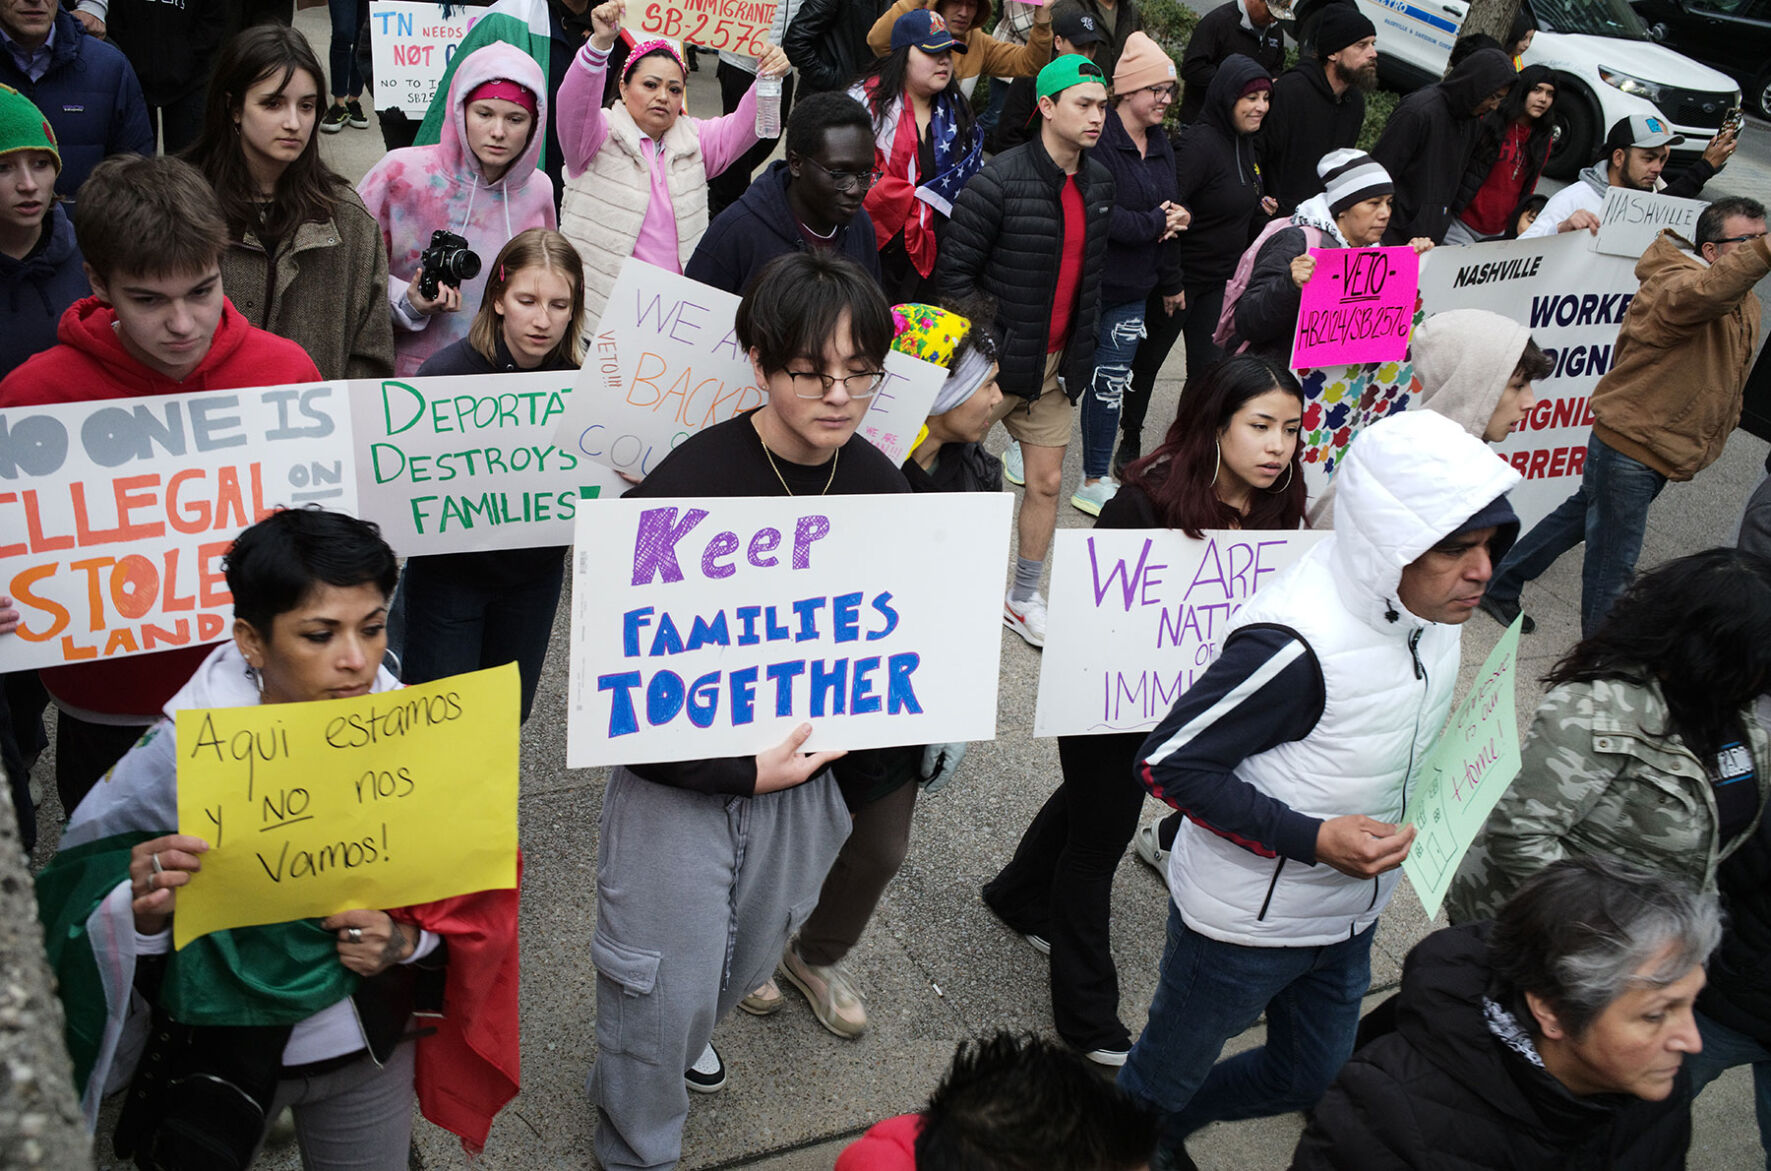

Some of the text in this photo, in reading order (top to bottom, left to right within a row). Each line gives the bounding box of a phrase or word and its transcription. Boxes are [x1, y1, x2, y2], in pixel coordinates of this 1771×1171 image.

[373, 11, 463, 38] TN NEEDS
[641, 3, 769, 56] SB-2576
[380, 79, 397, 88] NO
[405, 79, 421, 89] TO
[1602, 193, 1694, 226] NASHVILLE
[1453, 256, 1543, 288] NASHVILLE
[636, 288, 711, 345] WE
[1298, 305, 1408, 351] HB2124/SB2576
[597, 329, 622, 389] VETO!!!
[1541, 344, 1617, 378] DIGN
[81, 394, 248, 468] ONE
[261, 387, 336, 441] IS
[288, 460, 343, 488] ON
[371, 442, 578, 484] DESTROYS
[1498, 445, 1589, 480] BRER
[1087, 536, 1288, 612] WE ARE
[61, 613, 226, 661] LAND
[623, 591, 900, 658] FAMILIES
[1194, 642, 1216, 666] OF
[597, 651, 924, 739] TOGETHER
[191, 691, 463, 801] Aqui estamos
[262, 787, 311, 823] NO
[355, 766, 415, 804] nos
[256, 822, 391, 884] Vamos!
